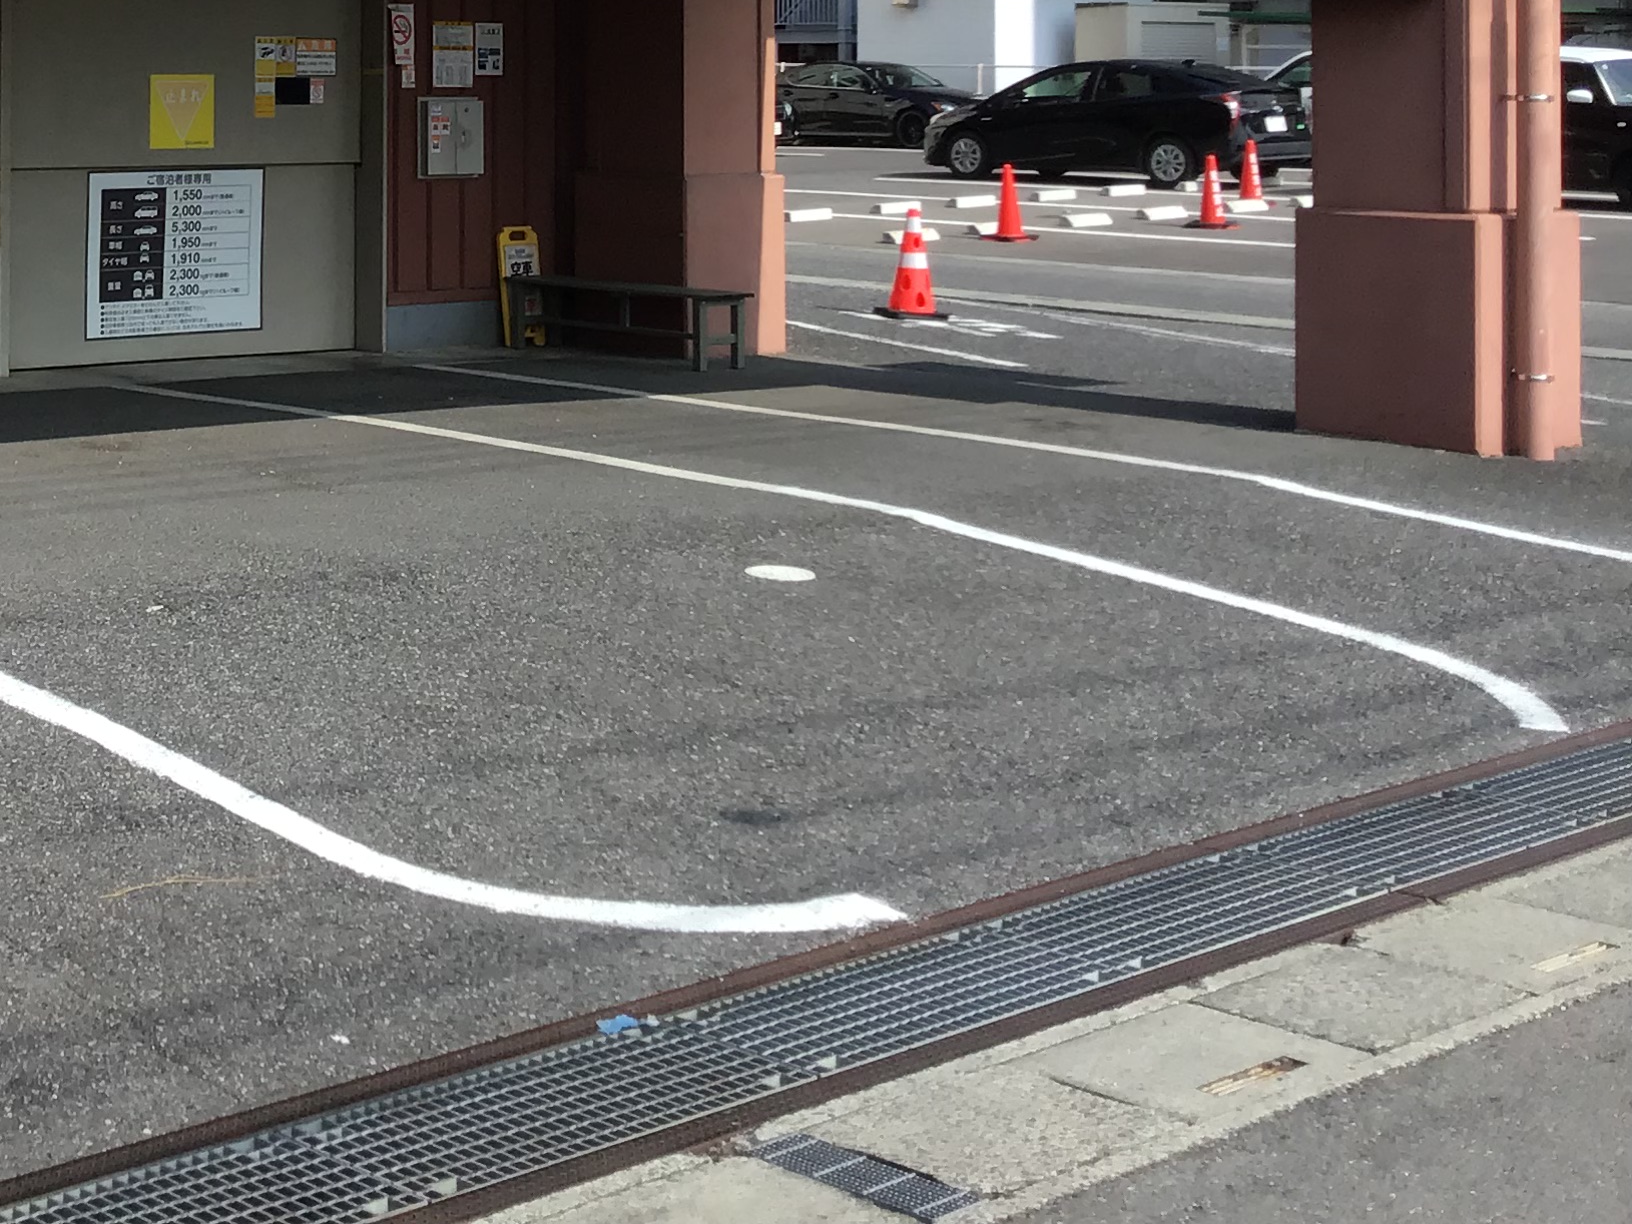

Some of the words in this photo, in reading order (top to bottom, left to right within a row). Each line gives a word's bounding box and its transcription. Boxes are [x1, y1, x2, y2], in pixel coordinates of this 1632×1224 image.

[173, 188, 203, 203] 1,550
[171, 205, 202, 219] 2,000
[171, 221, 202, 235] 5,300
[171, 236, 201, 251] 1,950
[171, 252, 200, 267] 1,910
[169, 268, 200, 283] 2,300
[169, 284, 199, 298] 2,300
